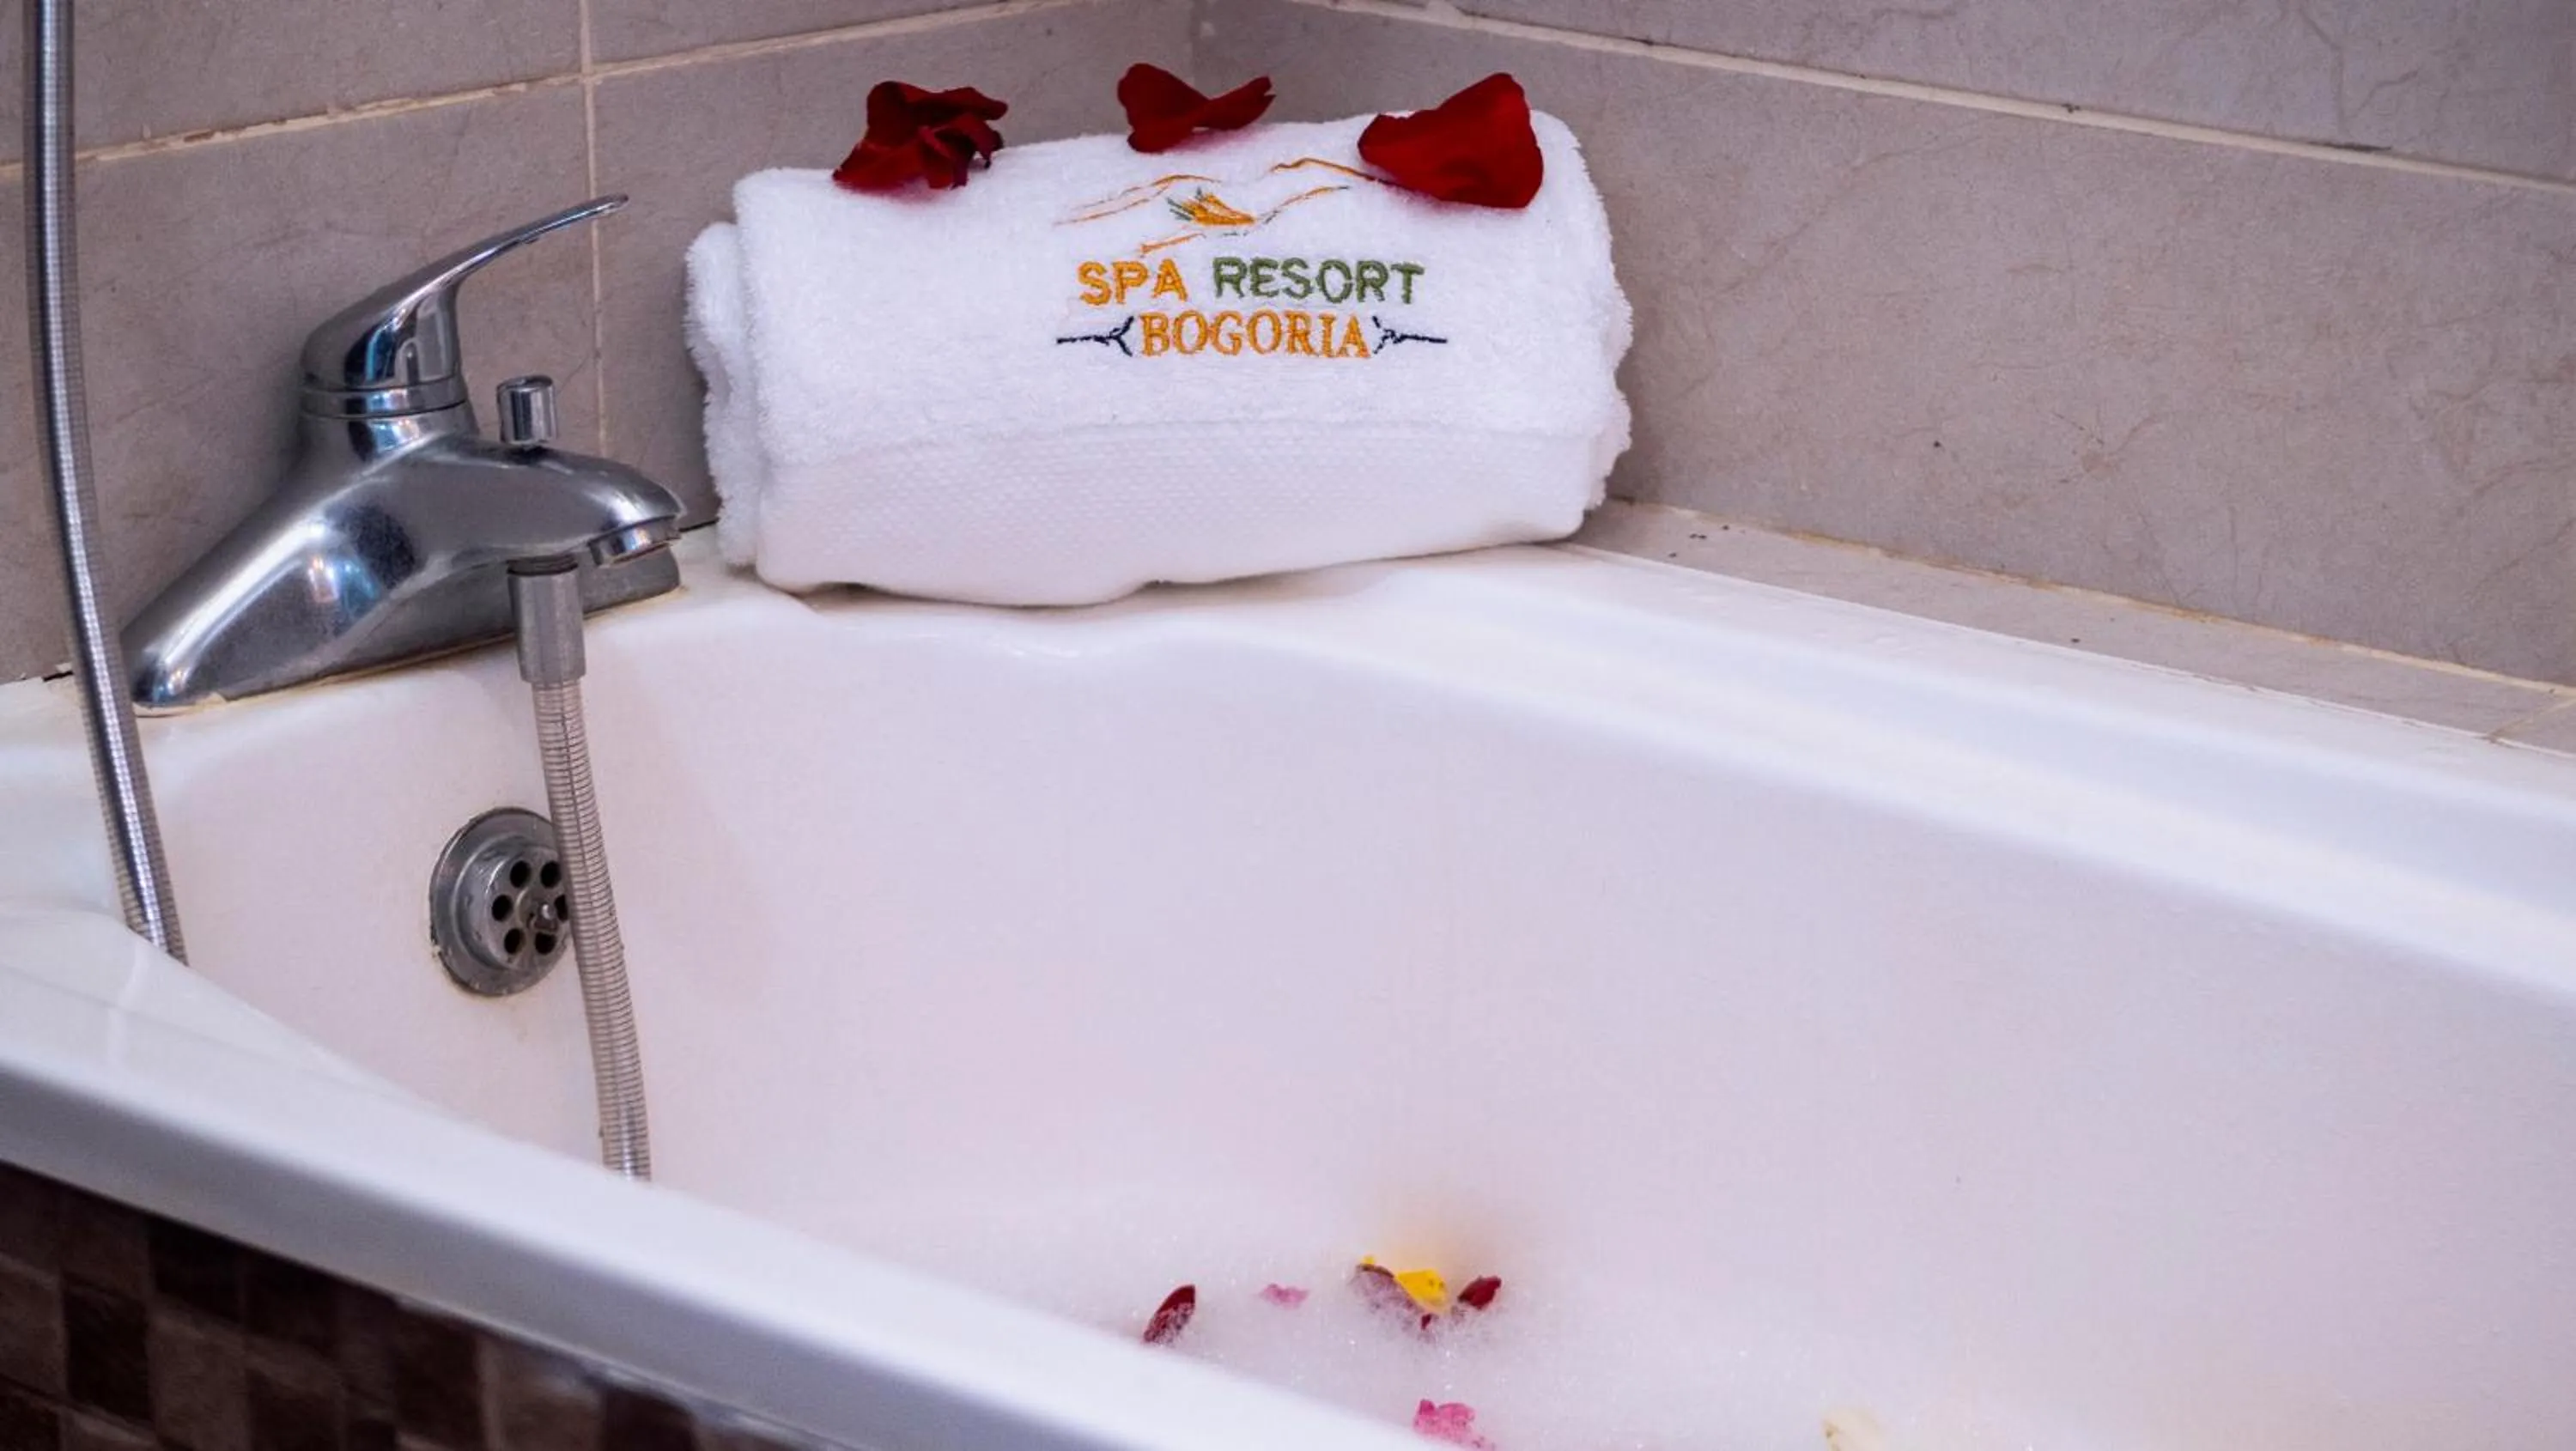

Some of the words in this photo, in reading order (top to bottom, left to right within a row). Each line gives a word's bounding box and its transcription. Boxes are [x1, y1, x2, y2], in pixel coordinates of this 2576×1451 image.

[1076, 258, 1188, 306] SPA
[1212, 257, 1425, 305] RESORT
[1139, 309, 1372, 358] BOGORIA
